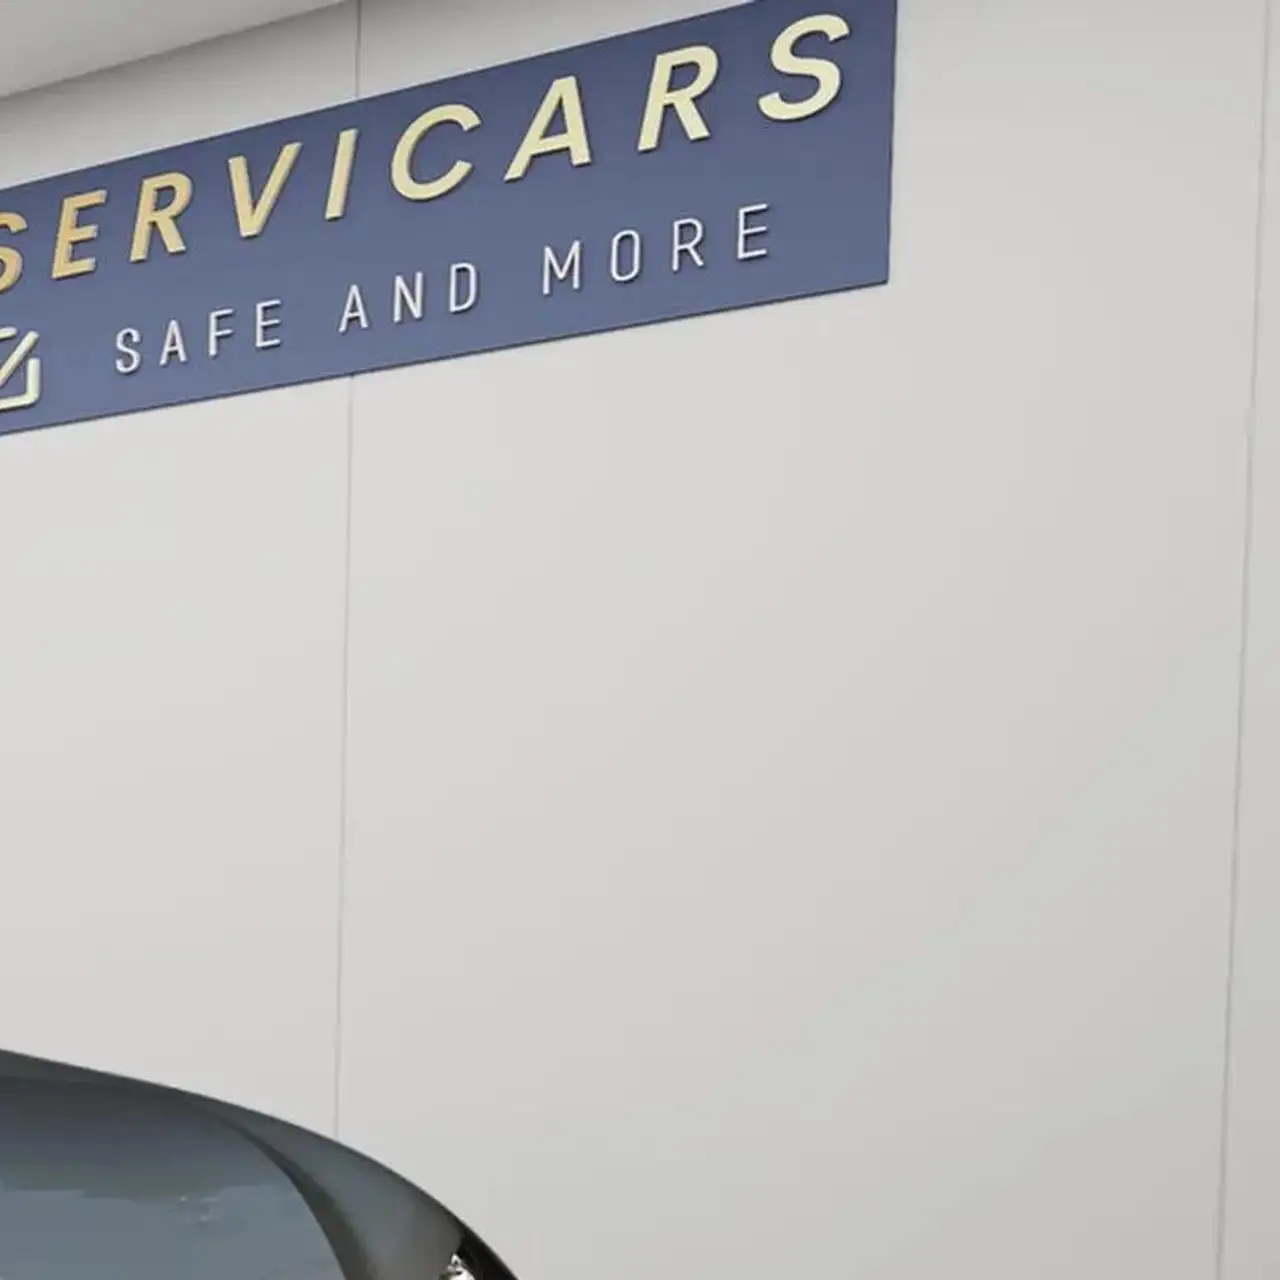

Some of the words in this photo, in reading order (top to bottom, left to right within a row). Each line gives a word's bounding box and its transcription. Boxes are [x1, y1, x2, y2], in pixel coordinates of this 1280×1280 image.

[114, 299, 282, 375] SAFE
[339, 262, 478, 333] AND
[542, 203, 769, 295] MORE
